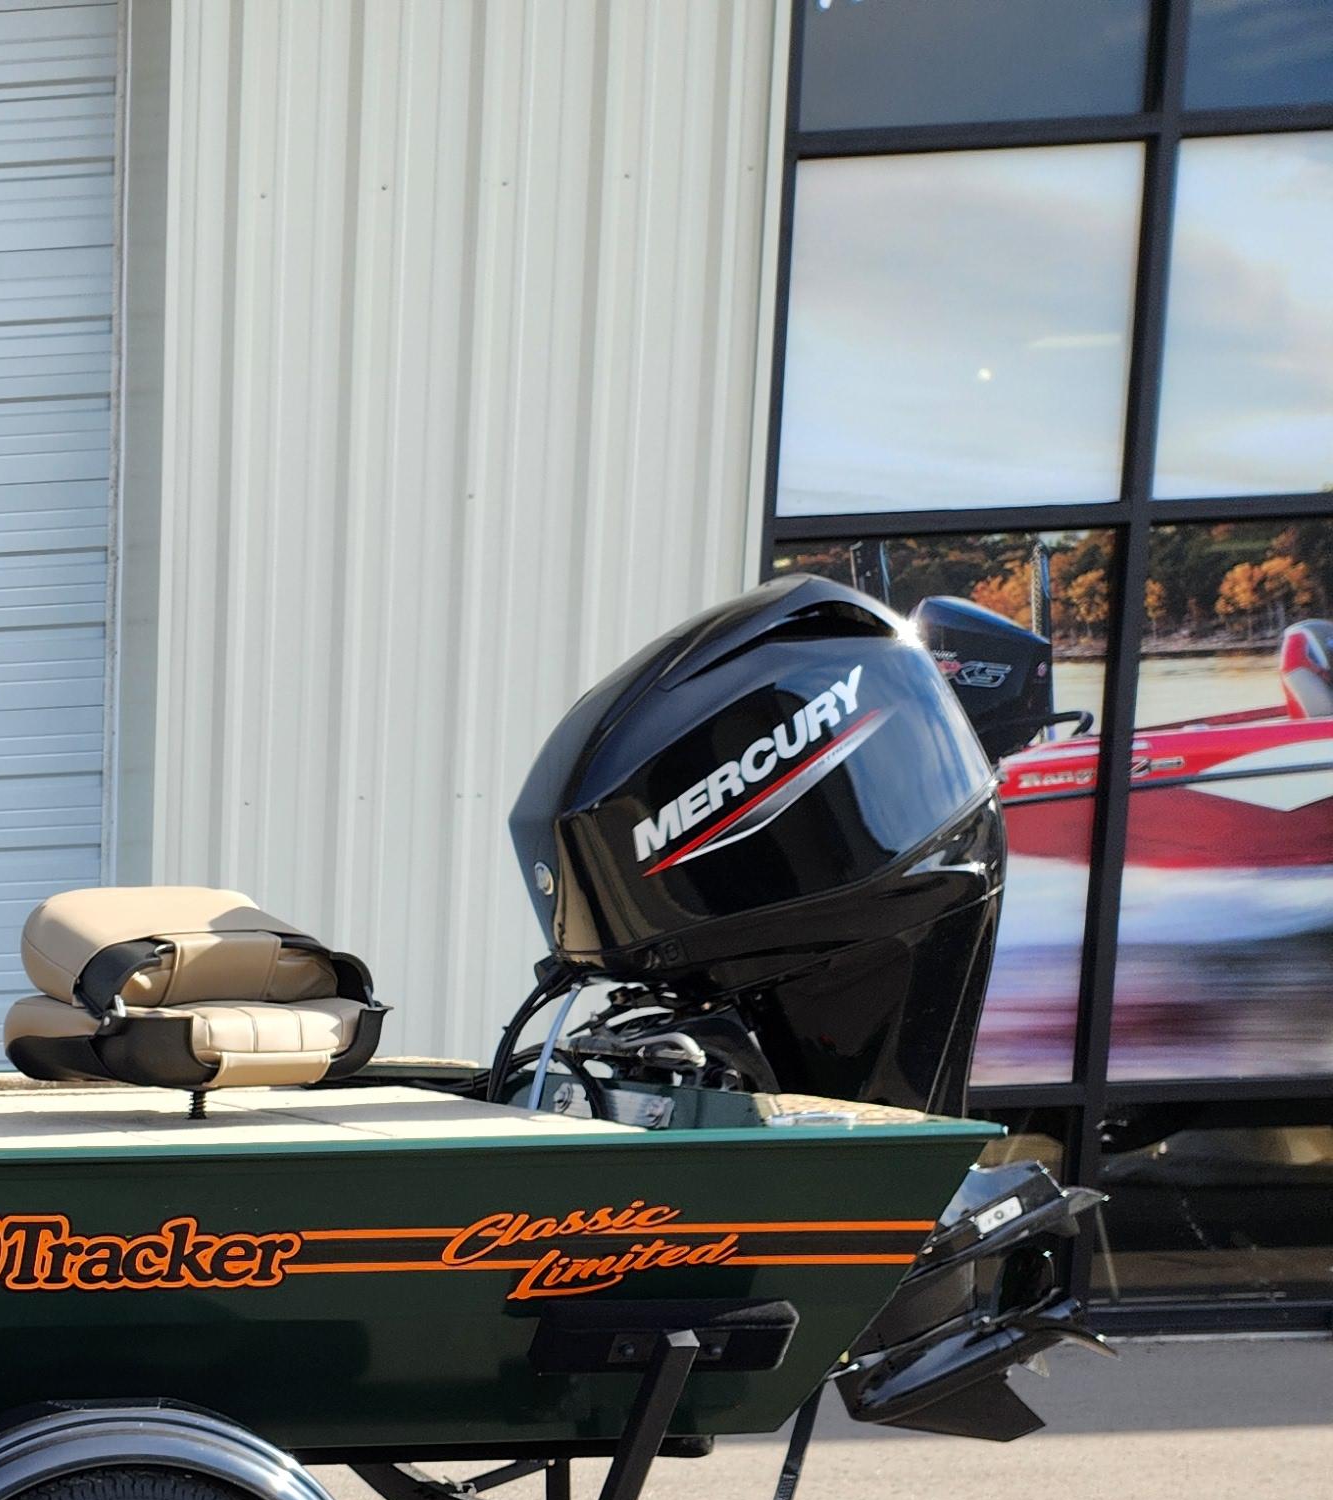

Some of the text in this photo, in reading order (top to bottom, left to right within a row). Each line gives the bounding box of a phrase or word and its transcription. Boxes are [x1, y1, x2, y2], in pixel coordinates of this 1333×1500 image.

[632, 664, 863, 862] MERCURY
[2, 1214, 303, 1291] Tracker
[441, 1199, 681, 1266] Classic
[506, 1233, 739, 1300] Limited
